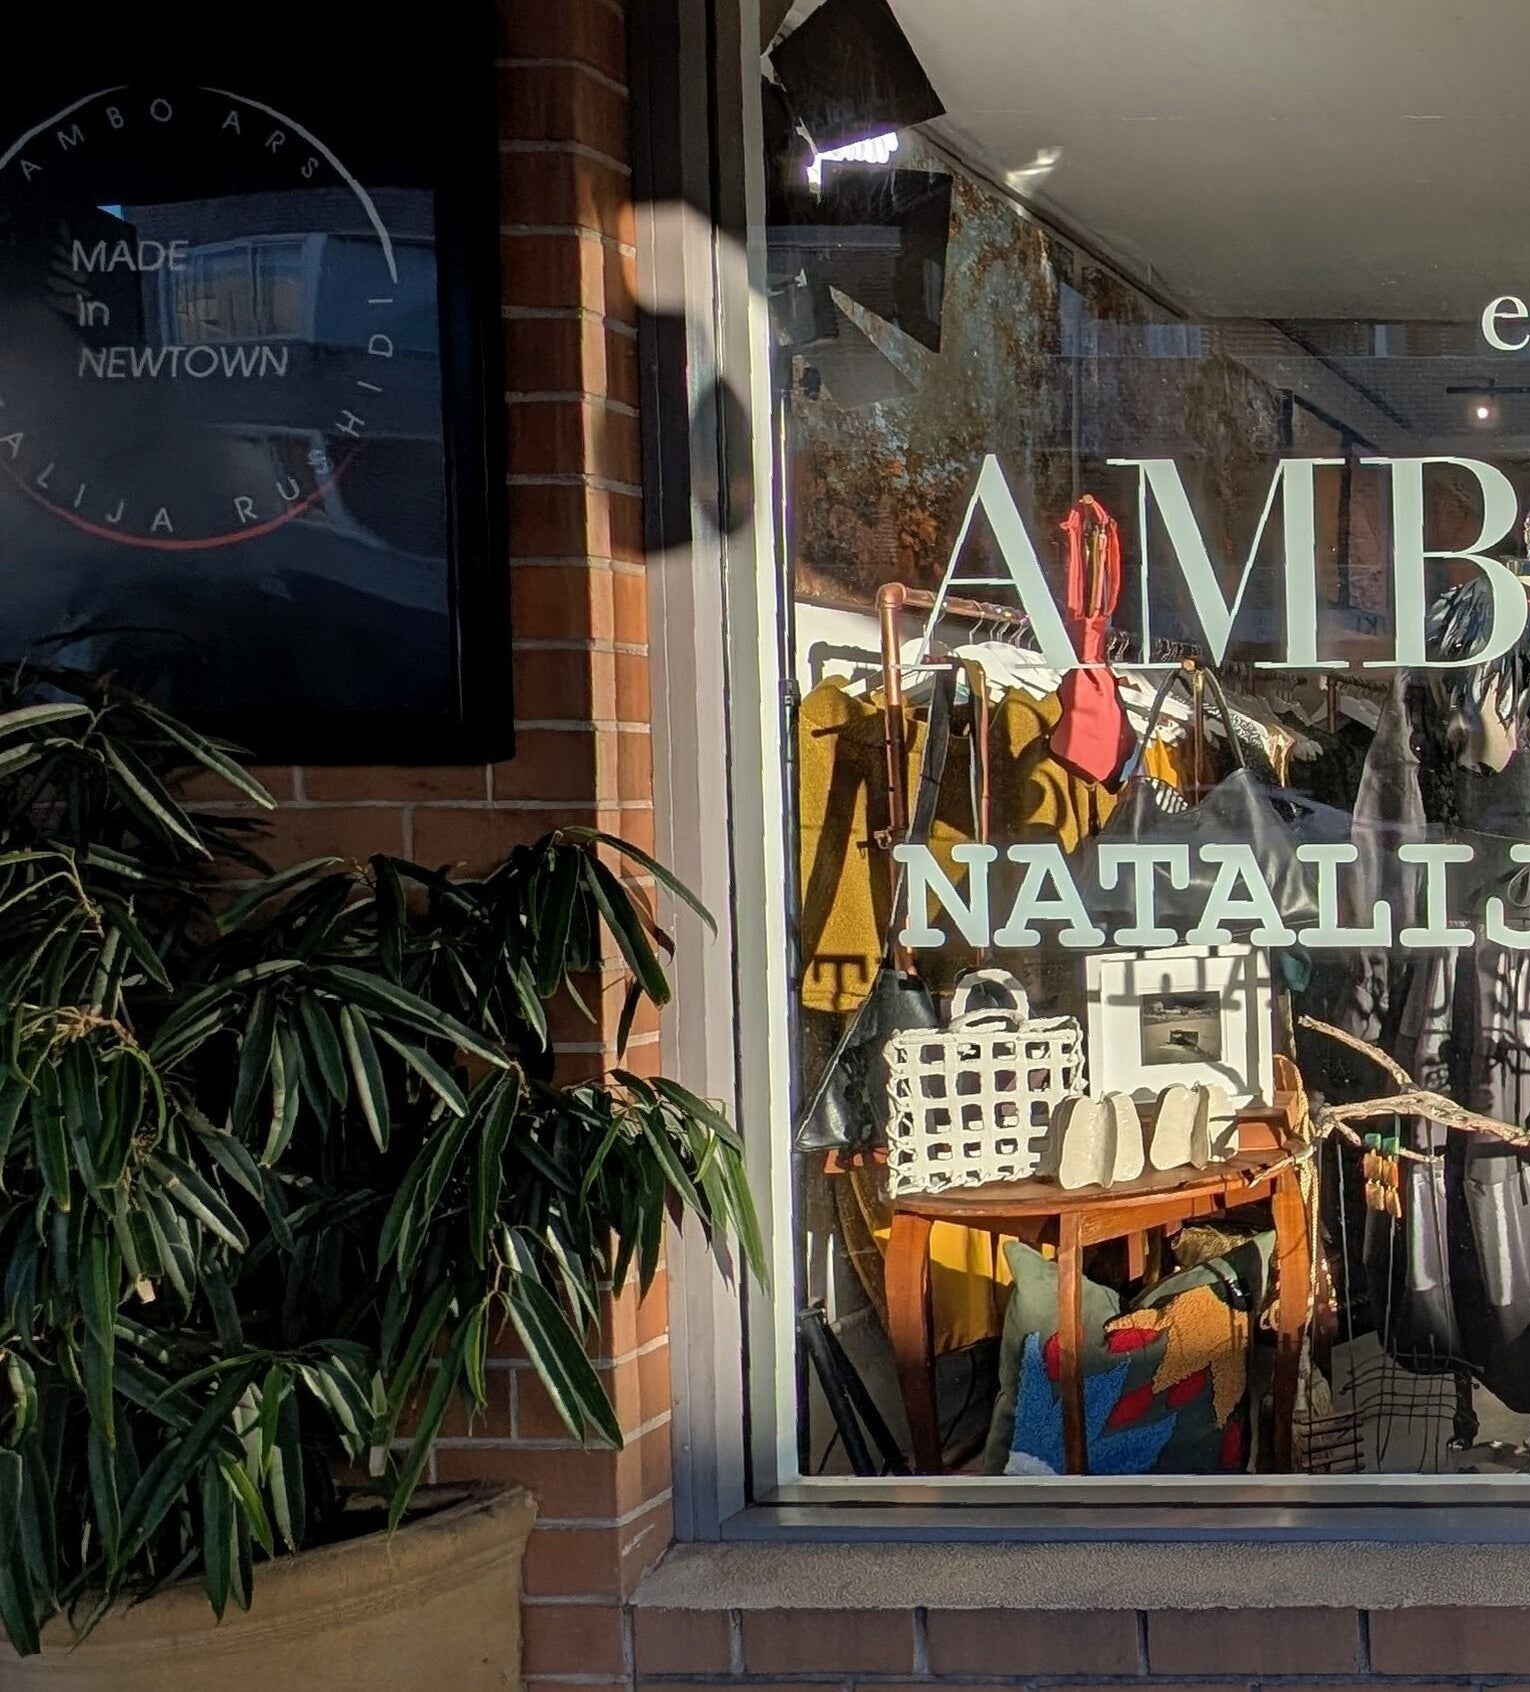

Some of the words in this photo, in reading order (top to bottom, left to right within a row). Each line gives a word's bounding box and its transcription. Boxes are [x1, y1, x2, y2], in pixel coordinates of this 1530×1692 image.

[20, 98, 173, 182] AMBO
[222, 109, 319, 179] ARS
[72, 240, 189, 271] MADE
[78, 345, 289, 378] NEWTOWN
[0, 397, 174, 532] ALIJA
[234, 298, 394, 523] RUSHIDI
